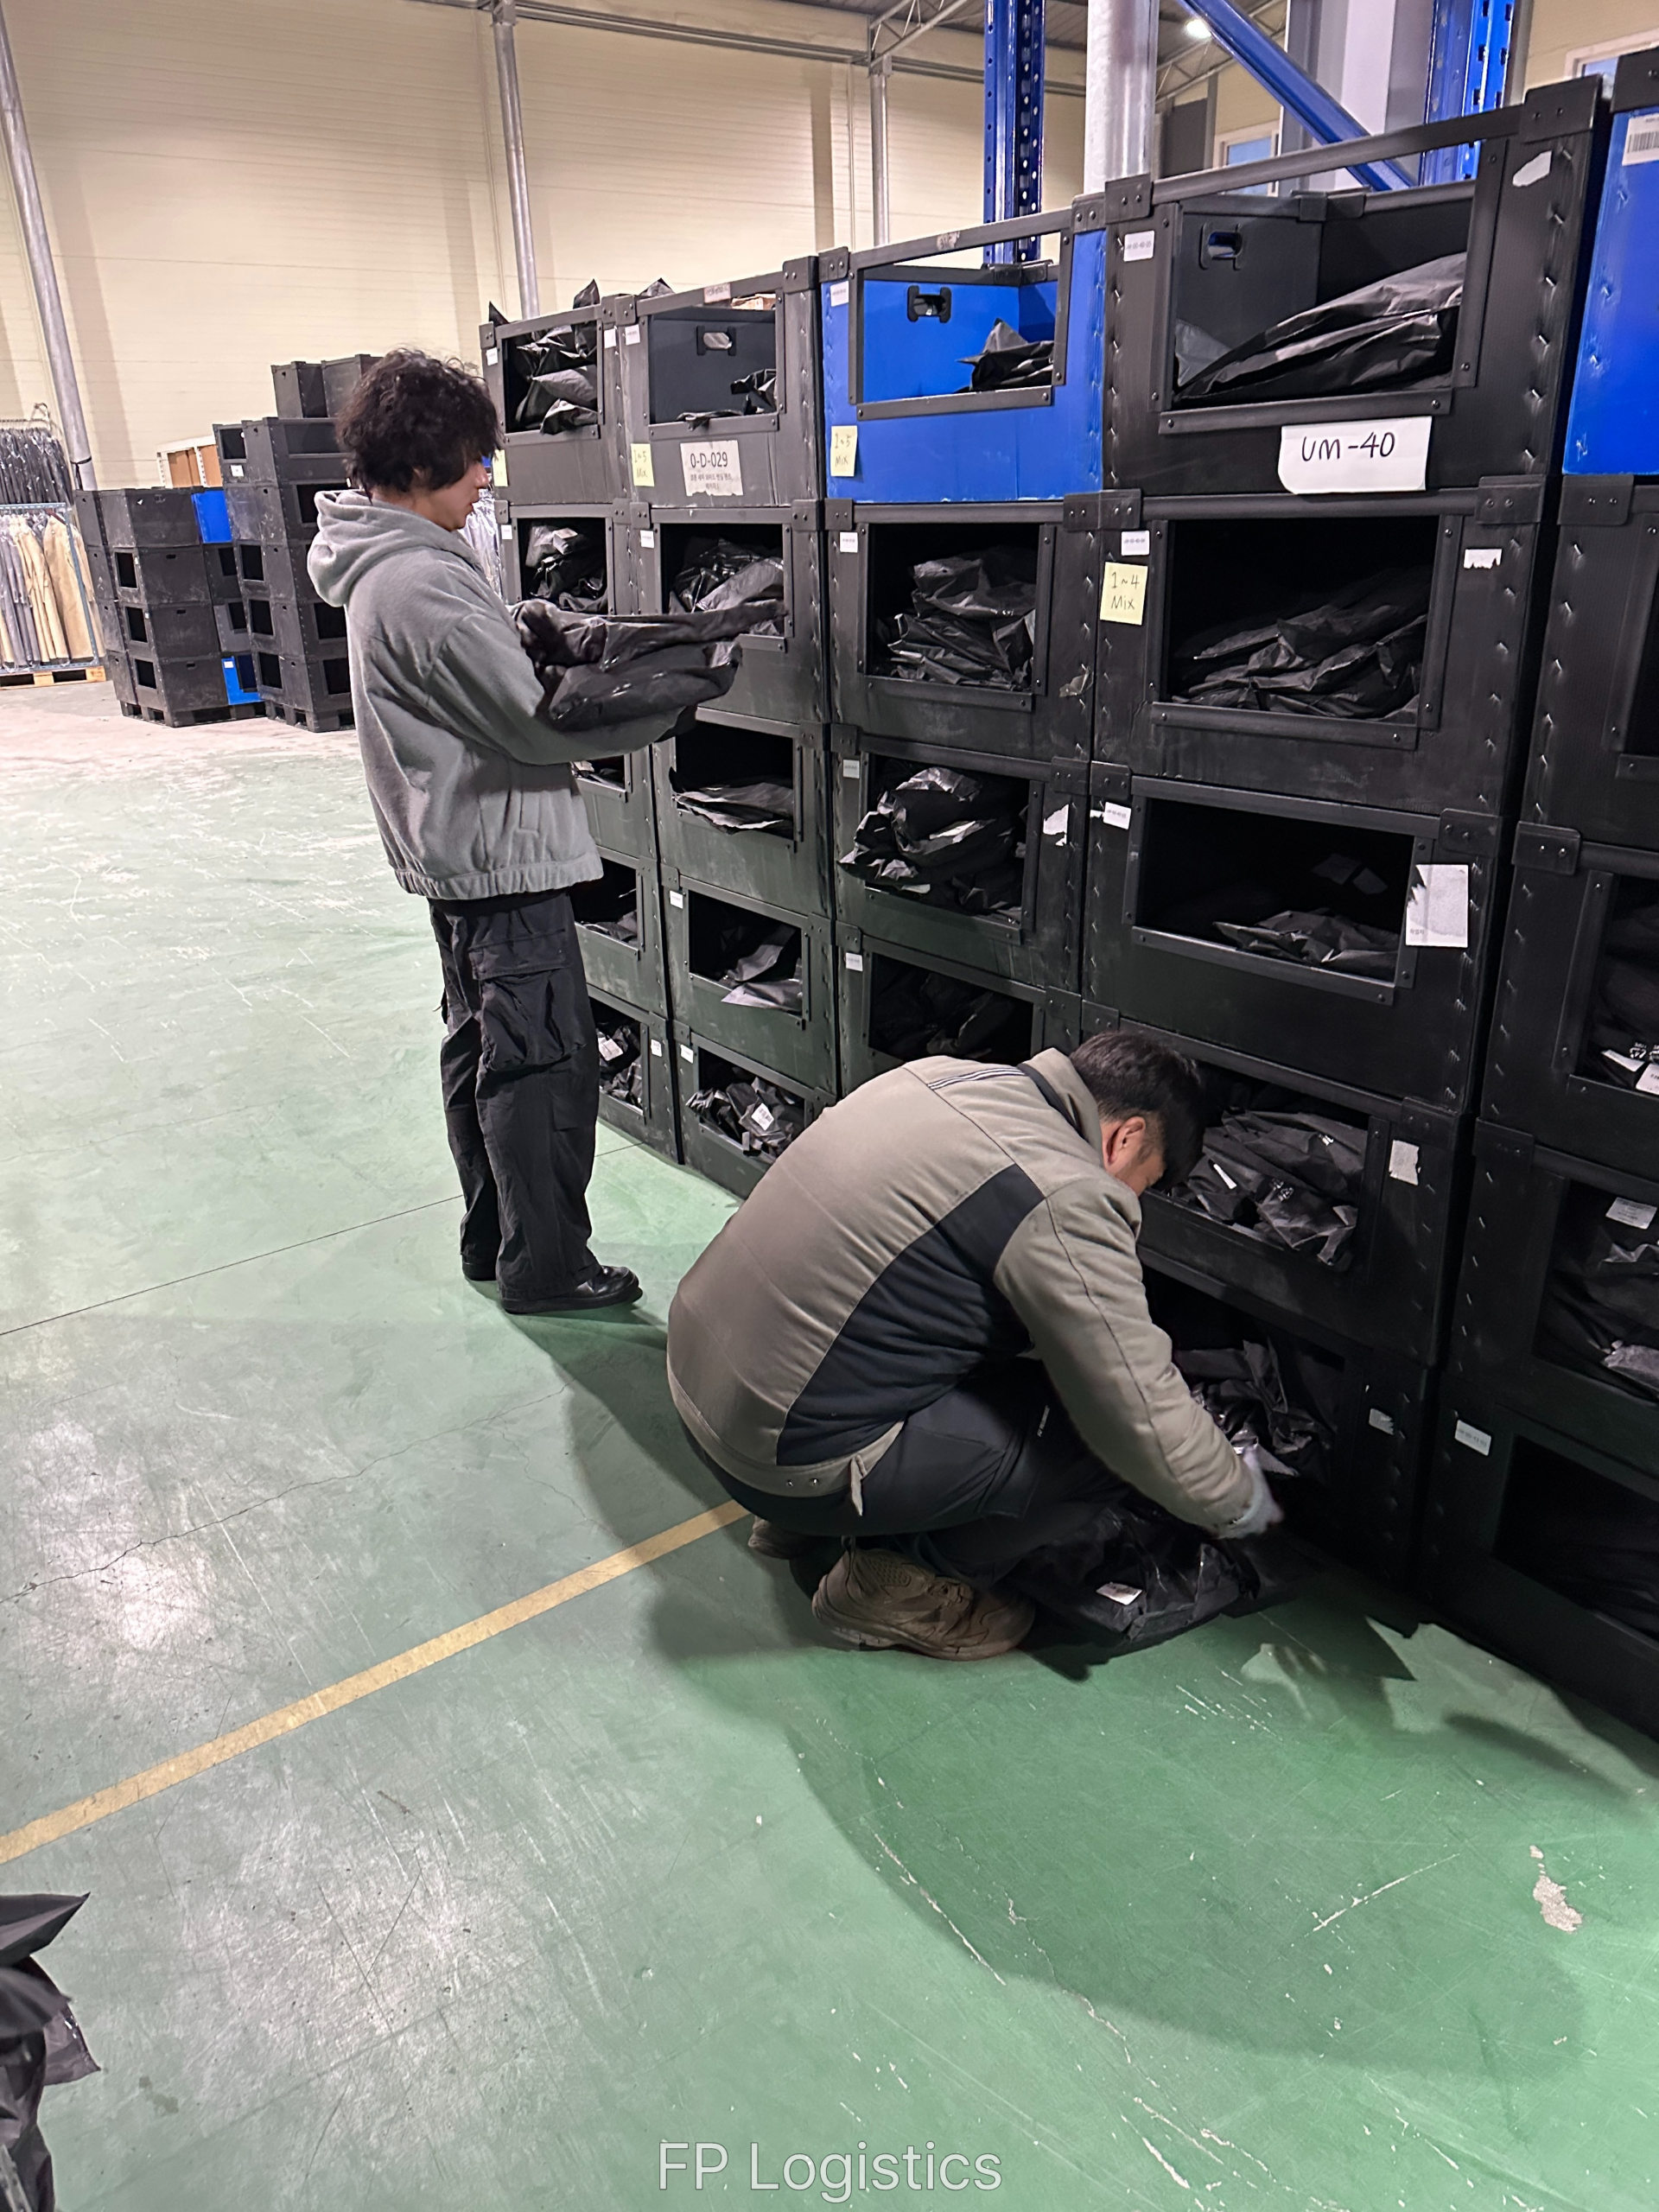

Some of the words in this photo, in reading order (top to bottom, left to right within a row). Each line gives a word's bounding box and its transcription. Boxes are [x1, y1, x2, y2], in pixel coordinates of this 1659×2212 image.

[1301, 431, 1395, 461] UM-40
[1111, 571, 1140, 589] 1~4
[1110, 594, 1135, 611] Mix
